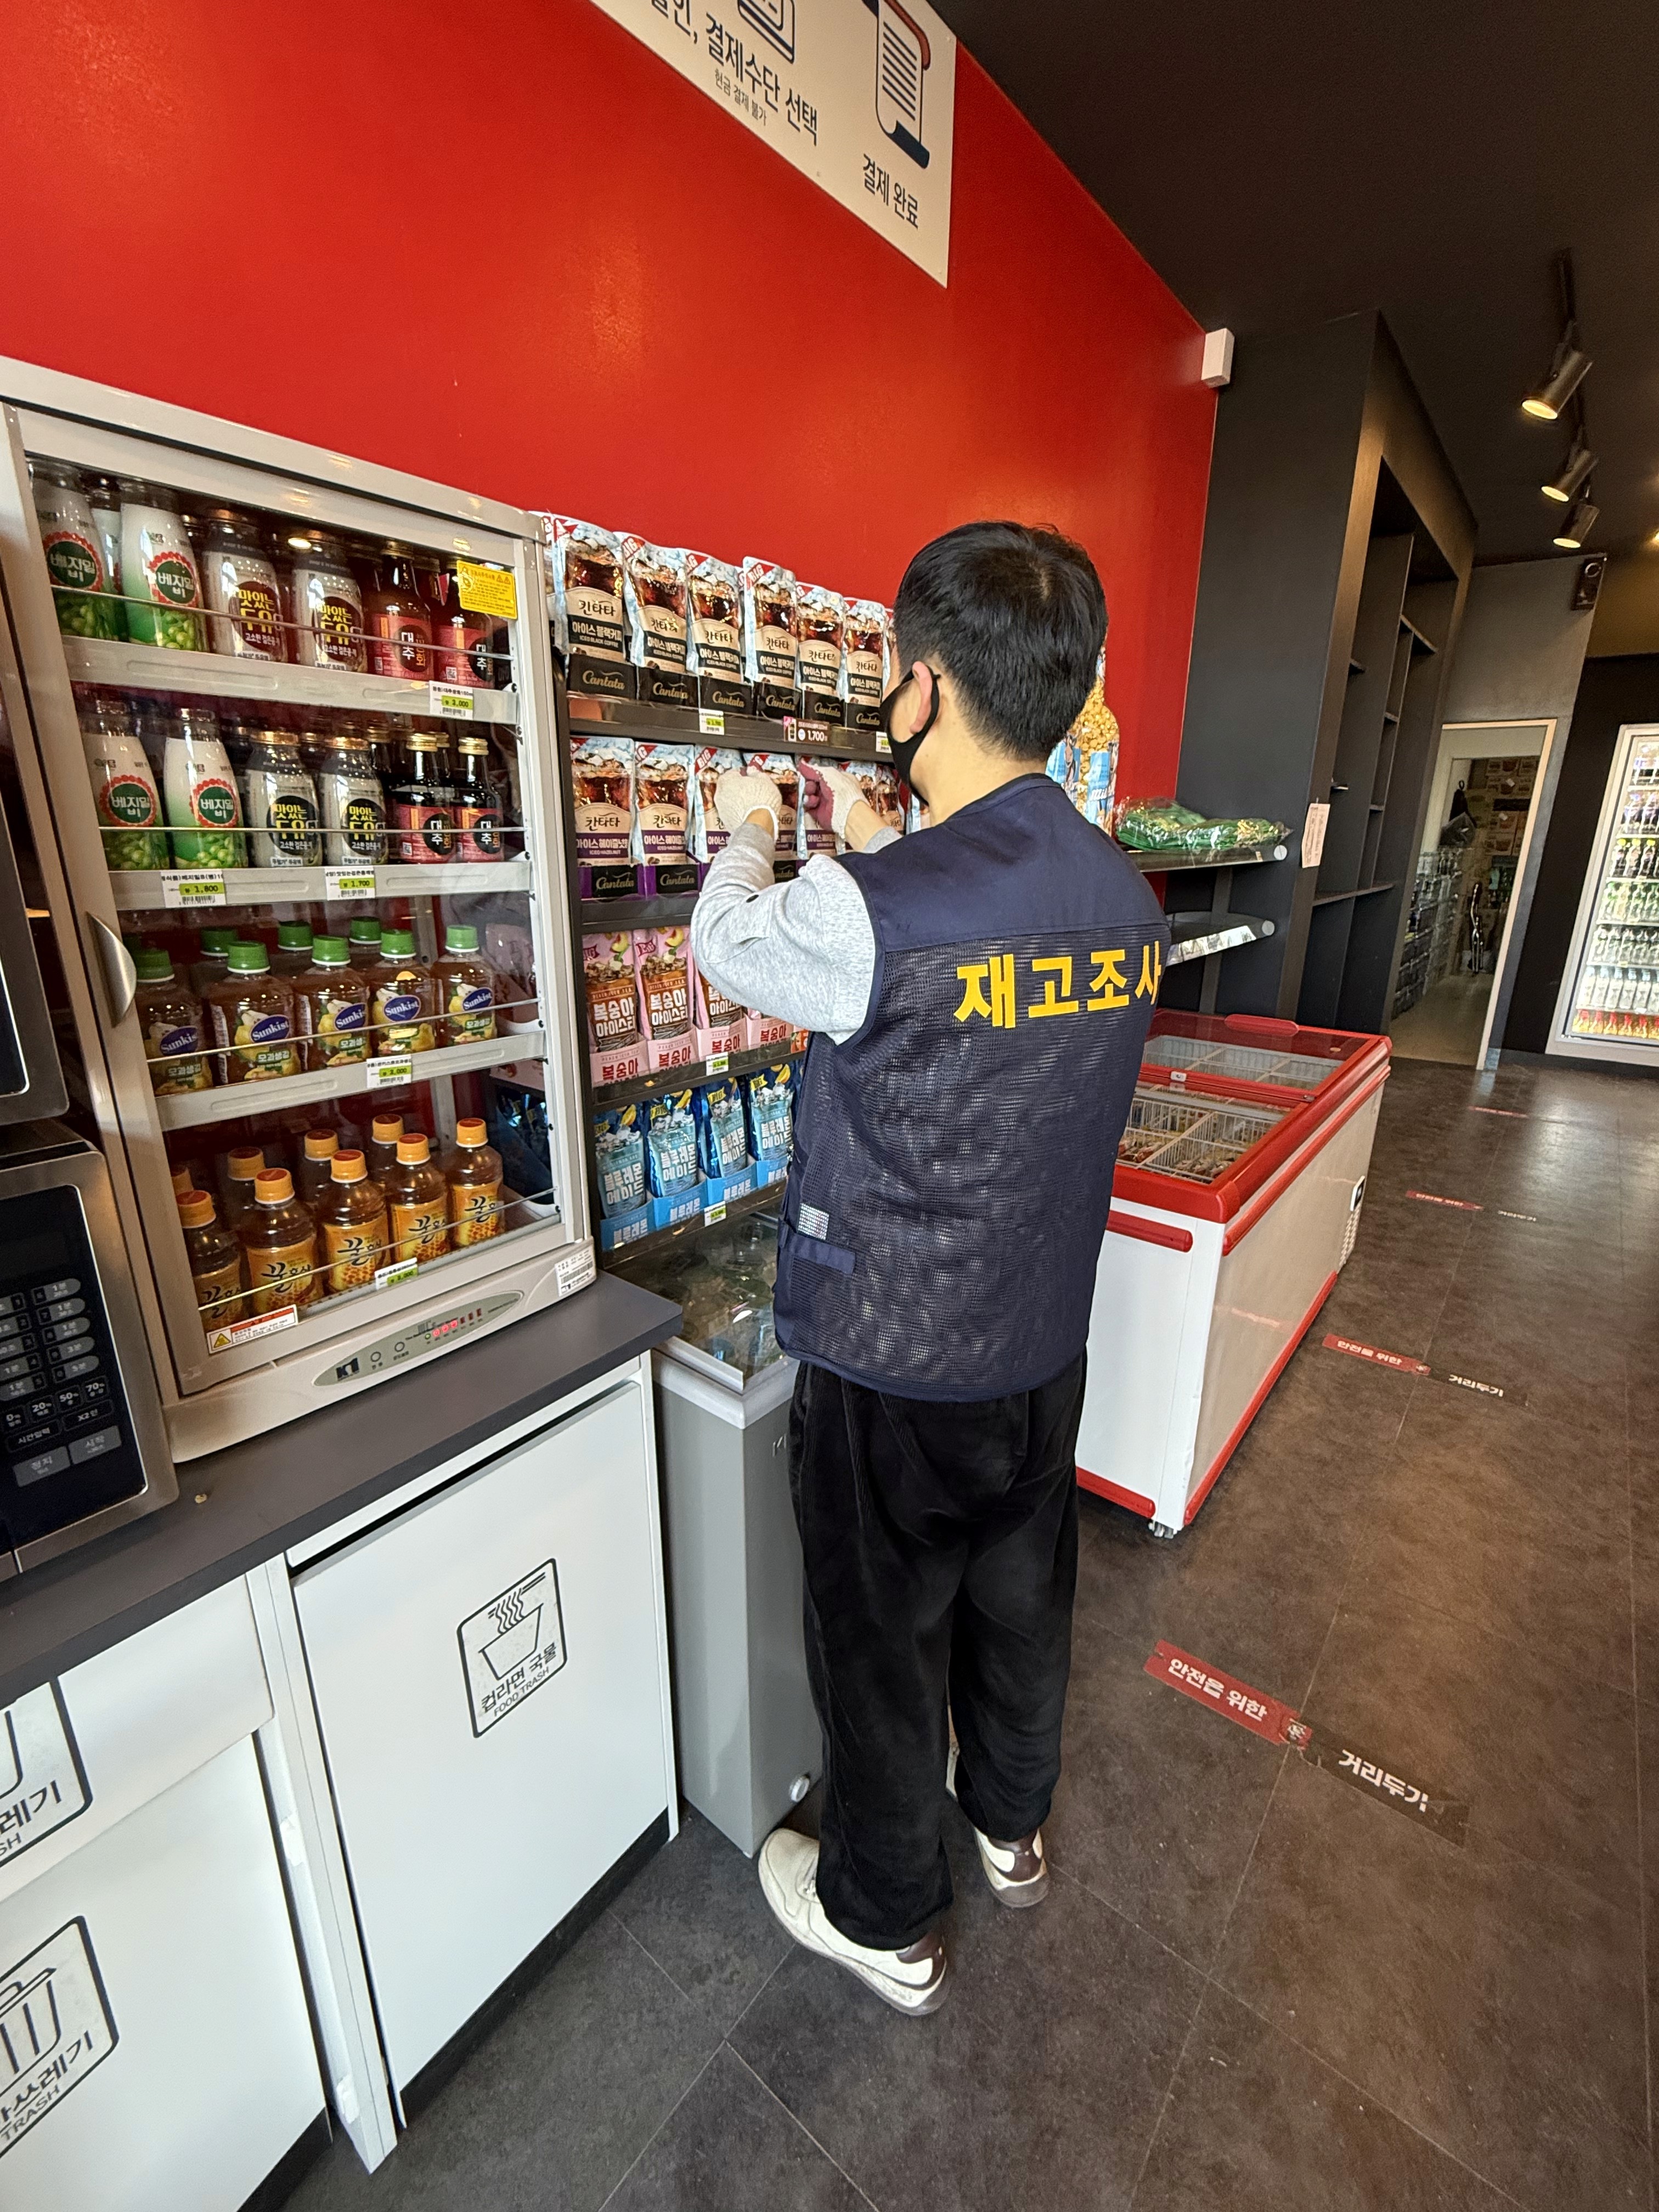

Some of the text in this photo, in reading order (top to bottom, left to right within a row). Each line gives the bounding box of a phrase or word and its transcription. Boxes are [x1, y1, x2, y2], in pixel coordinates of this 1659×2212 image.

[706, 12, 780, 112] 결제수단
[786, 88, 817, 146] 선택
[715, 68, 767, 126] 현금 결제 불가
[863, 153, 919, 230] 결제 완료
[747, 565, 764, 583] BIG
[572, 622, 622, 642] 아이스 블랙커피
[401, 631, 415, 661] 대추
[647, 635, 664, 650] 아이스
[766, 637, 789, 650] 칸타타
[699, 647, 718, 661] 아이스
[760, 656, 777, 667] 아이스
[582, 670, 625, 690] Cantata
[803, 666, 820, 677] 아이스
[653, 682, 688, 699] Cantata
[850, 678, 865, 686] 아이스
[713, 691, 744, 708] Cantata
[766, 695, 795, 711] Cantata
[814, 702, 841, 717] Cantata
[856, 713, 880, 725] Cantata
[696, 749, 710, 769] BIG
[111, 796, 150, 808] 베지밀
[200, 798, 233, 810] 베지밀
[431, 820, 443, 845] 대추
[481, 821, 492, 845] 대추
[585, 816, 620, 831] 칸타타
[576, 838, 599, 849] 아이스
[644, 836, 665, 845] 아이스
[596, 877, 634, 889] Cantata
[660, 873, 695, 886] Cantata
[953, 940, 1161, 1029] 재고조사
[385, 1000, 419, 1015] Sunkist
[464, 992, 492, 1009] Sunkist
[594, 997, 634, 1022] 복숭아
[650, 988, 686, 1011] 복숭아
[709, 1000, 741, 1015] 아이스
[336, 1009, 366, 1028] Sunki
[652, 1005, 688, 1026] 아이스티
[596, 1016, 635, 1037] 아이스티
[760, 1024, 787, 1042] 복숭아
[161, 1034, 198, 1053] Sunkis
[712, 1034, 740, 1053] 복숭아
[659, 1045, 691, 1068] 복숭아
[602, 1058, 639, 1080] 복숭아
[761, 1115, 789, 1137] 블루레몬
[720, 1127, 744, 1153] 블루레몬
[763, 1132, 792, 1149] 에이드
[661, 1143, 695, 1169] 블루레몬
[723, 1143, 746, 1164] 에이드
[605, 1163, 642, 1192] 블루레몬
[663, 1160, 696, 1182] 에이드
[607, 1181, 644, 1205] 에이드
[1448, 1374, 1504, 1397] 거리두기
[482, 1643, 556, 1712] 컵라면 국물
[493, 1667, 549, 1717] FOOD TRASH
[1168, 1658, 1429, 1812] 안전을 위한 거리두기
[1, 2084, 60, 2140] TRASH
